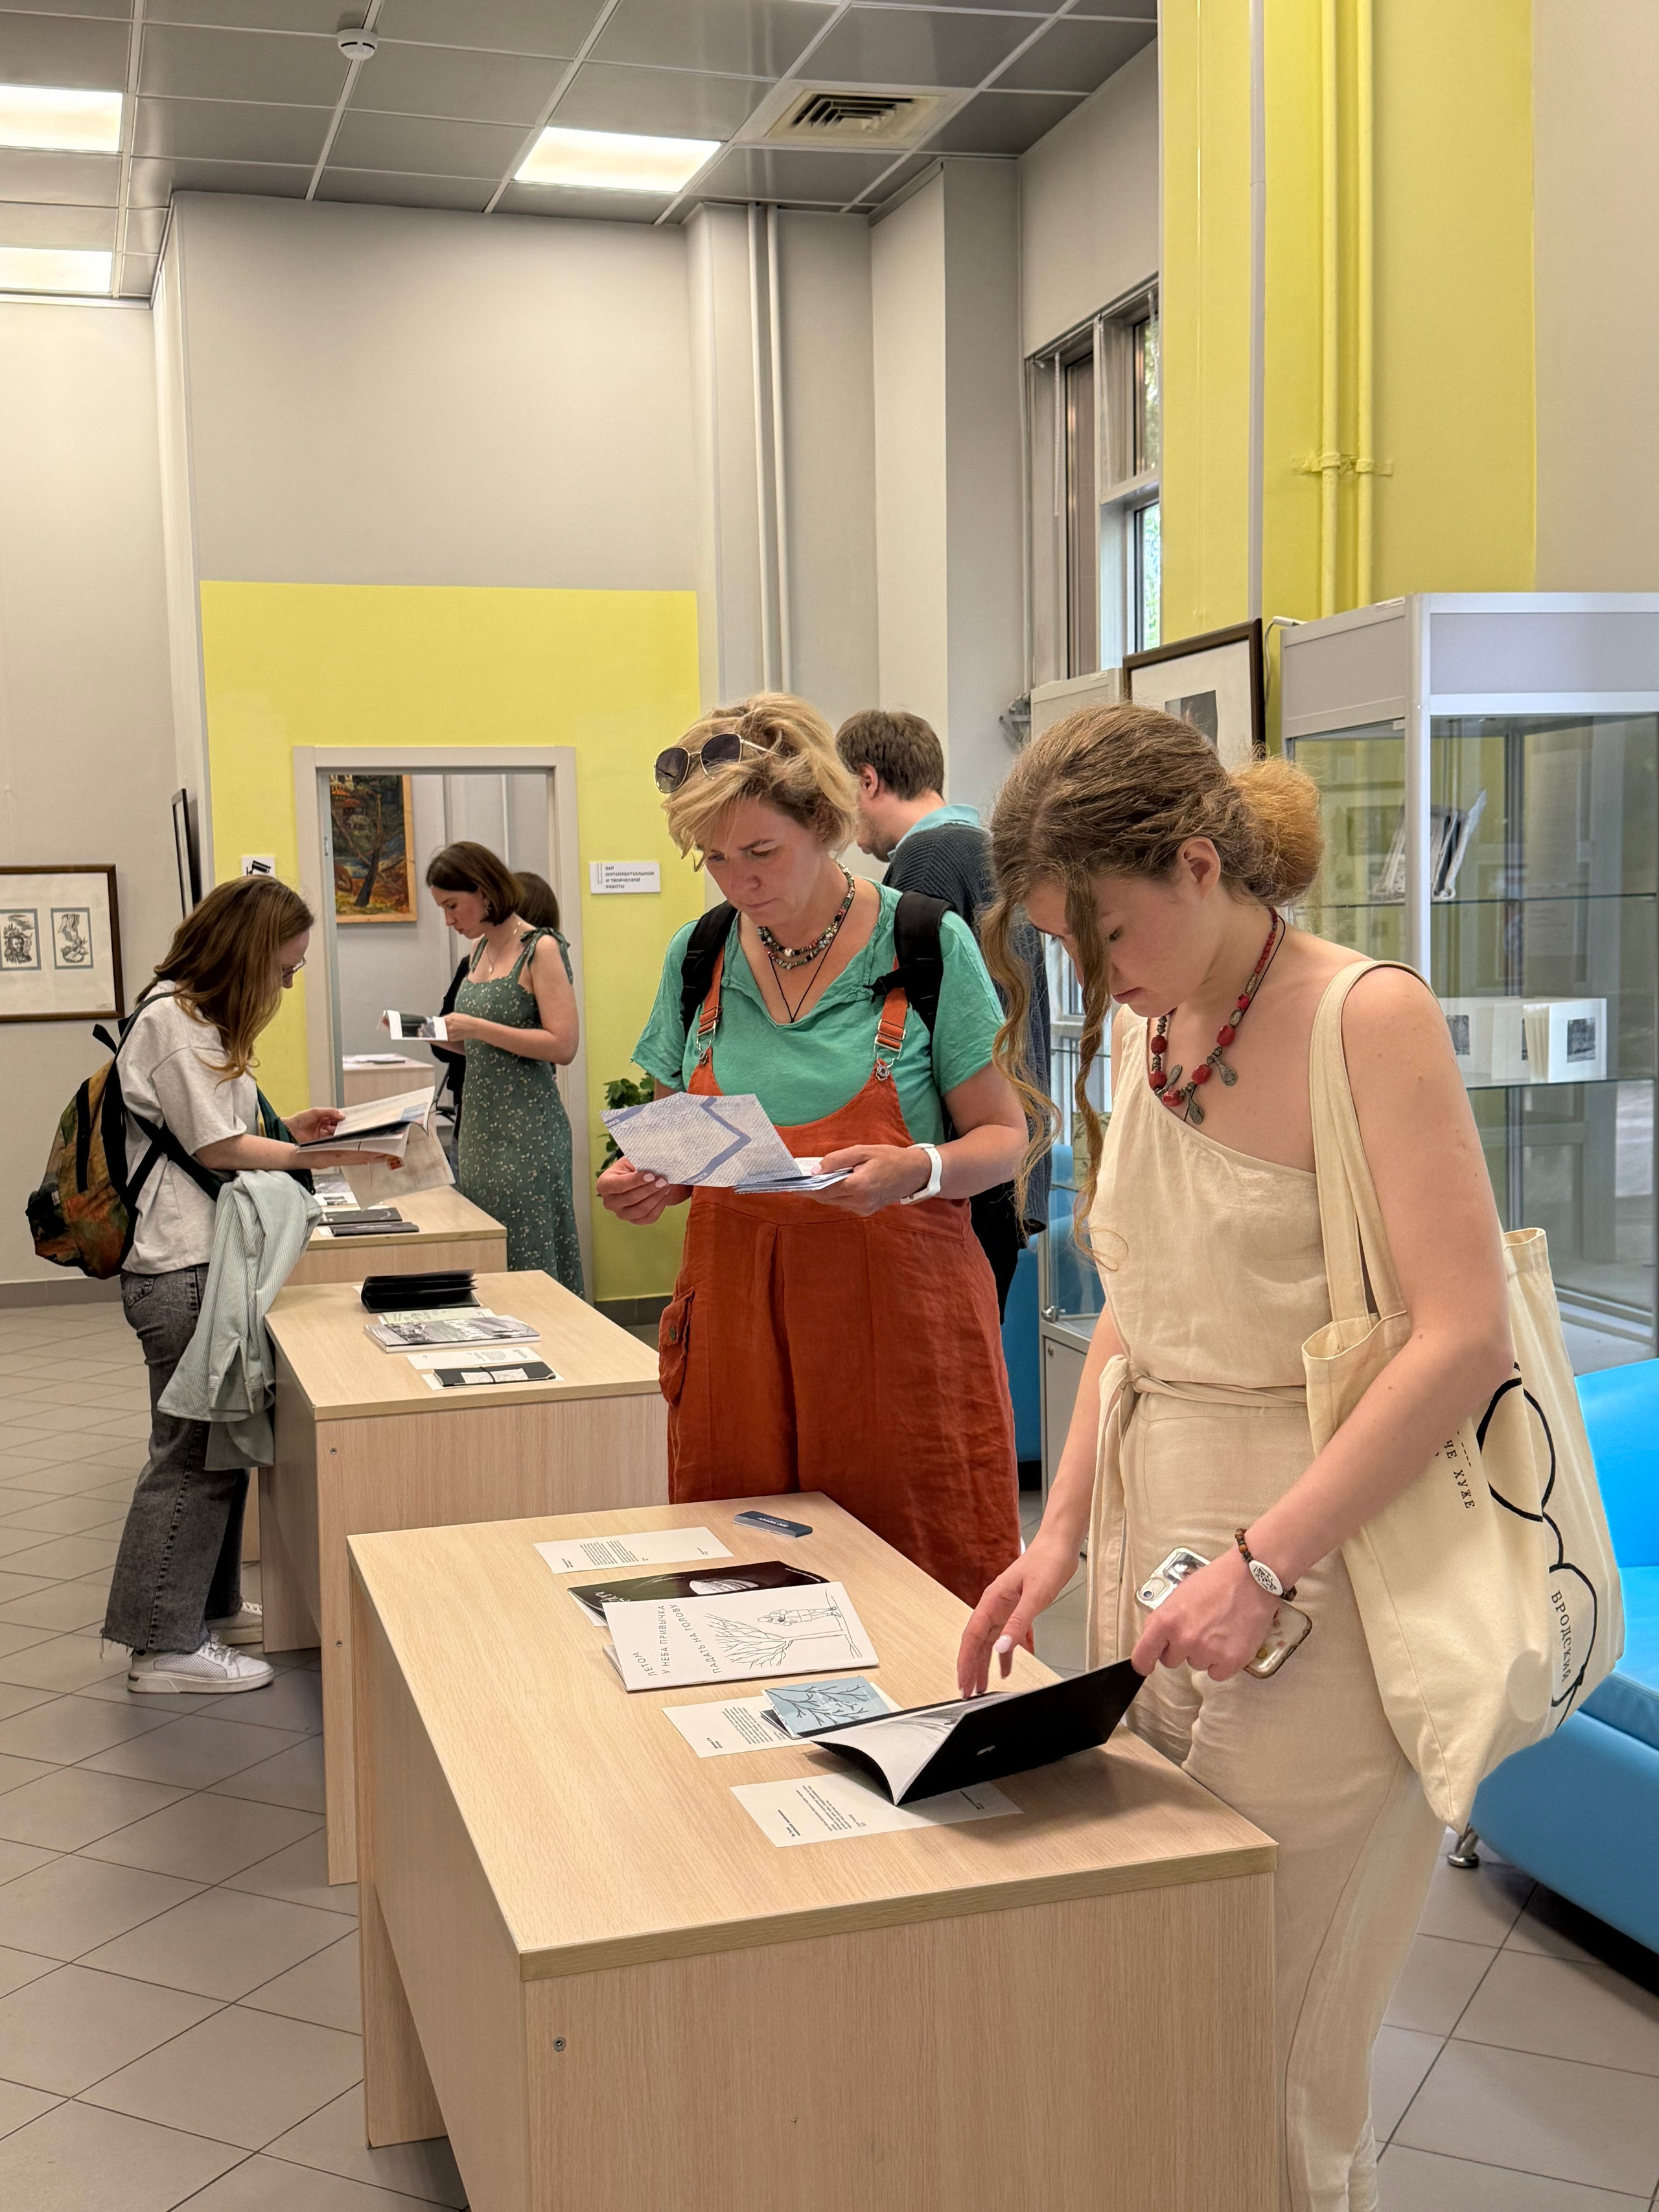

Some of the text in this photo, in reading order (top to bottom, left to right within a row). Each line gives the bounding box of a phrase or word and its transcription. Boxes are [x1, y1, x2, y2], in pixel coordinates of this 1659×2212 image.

[1444, 1439, 1475, 1509] ЧЕ ХУЖЕ
[657, 1605, 668, 1644] ПРИВЫЧКА
[669, 1604, 722, 1674] ПАДАТЬ НА ГОЛОВУ
[1551, 1590, 1572, 1684] БРОДСКИЙ
[632, 1651, 657, 1677] ЛЕТОМ
[660, 1647, 670, 1667] НЕБА
